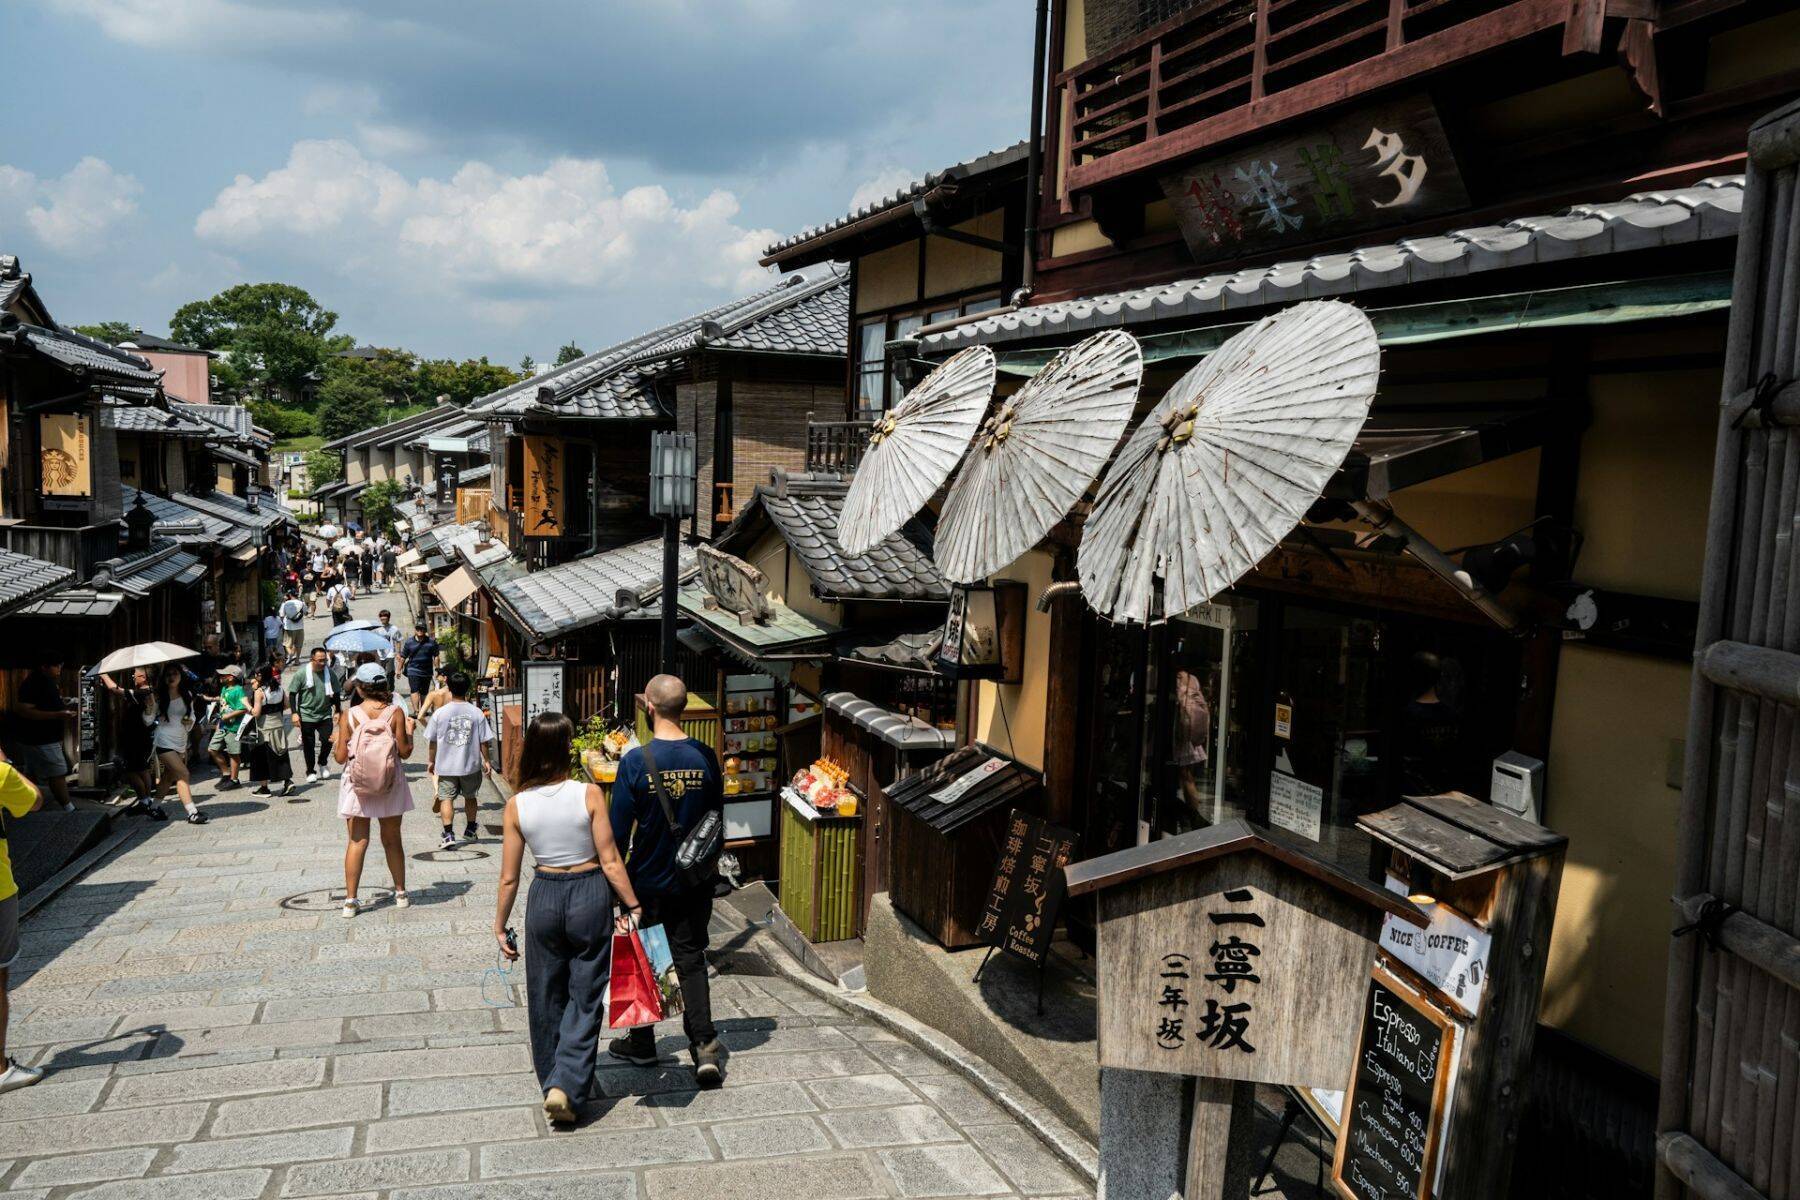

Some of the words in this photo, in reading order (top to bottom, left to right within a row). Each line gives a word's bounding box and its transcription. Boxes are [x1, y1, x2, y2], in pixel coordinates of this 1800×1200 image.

[1023, 836, 1054, 896] 二寧坂
[1009, 925, 1035, 946] Coffee
[1390, 927, 1414, 947] NICE
[1428, 934, 1469, 956] COFFEE
[1009, 939, 1040, 962] Roaster
[1195, 889, 1266, 1053] 二寧坂
[1373, 990, 1421, 1045] Espresso
[1376, 1026, 1415, 1072] Italiano
[1408, 1111, 1422, 1131] 400
[1405, 1128, 1419, 1150] 650
[1401, 1143, 1415, 1166] 600
[1396, 1171, 1410, 1194] 550
